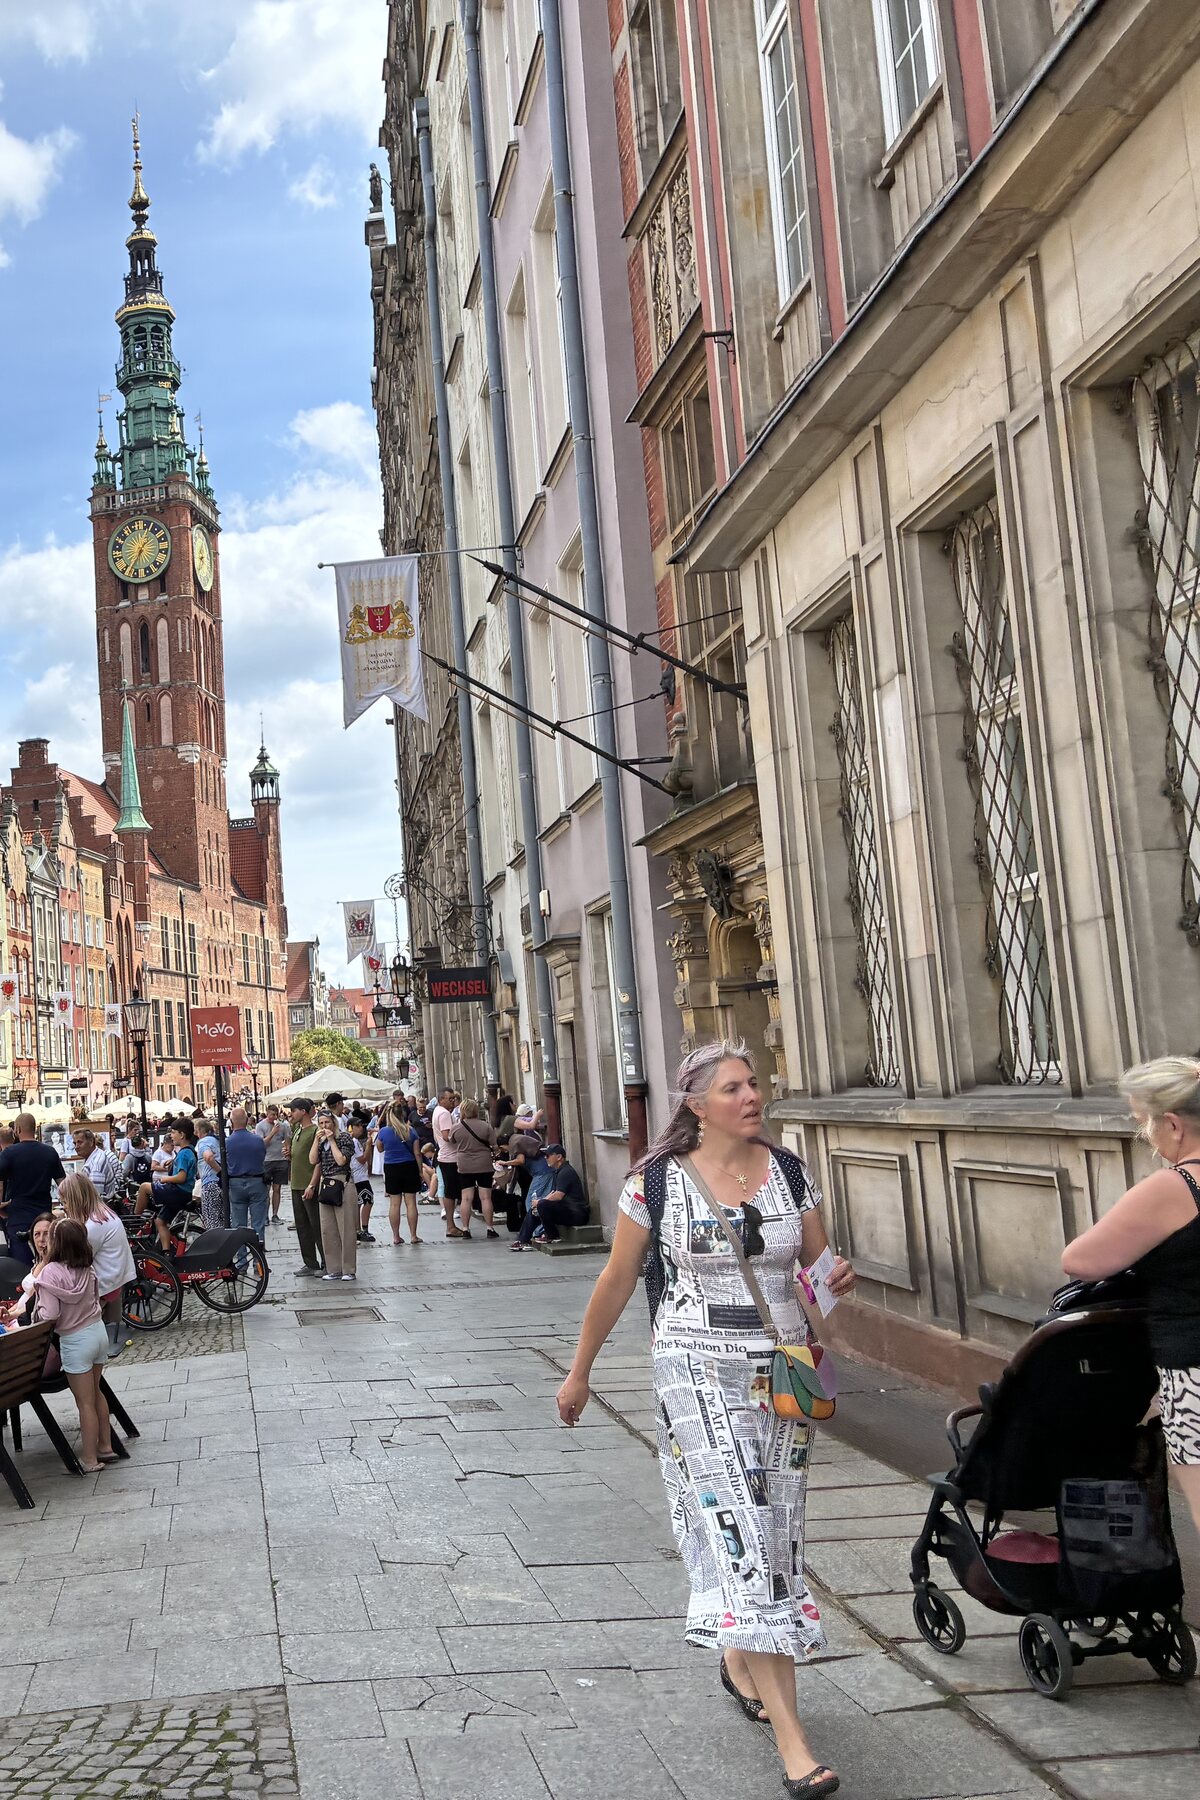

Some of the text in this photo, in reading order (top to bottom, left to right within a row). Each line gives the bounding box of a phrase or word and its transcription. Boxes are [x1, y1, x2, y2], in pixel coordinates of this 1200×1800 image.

[431, 980, 490, 997] WECHSEL
[666, 1168, 686, 1249] Art of Fashion
[655, 1339, 673, 1351] The
[704, 1391, 717, 1408] The
[710, 1410, 727, 1432] Art
[718, 1435, 730, 1449] of
[721, 1447, 747, 1506] Fashion
[757, 1533, 770, 1578] CHARTS
